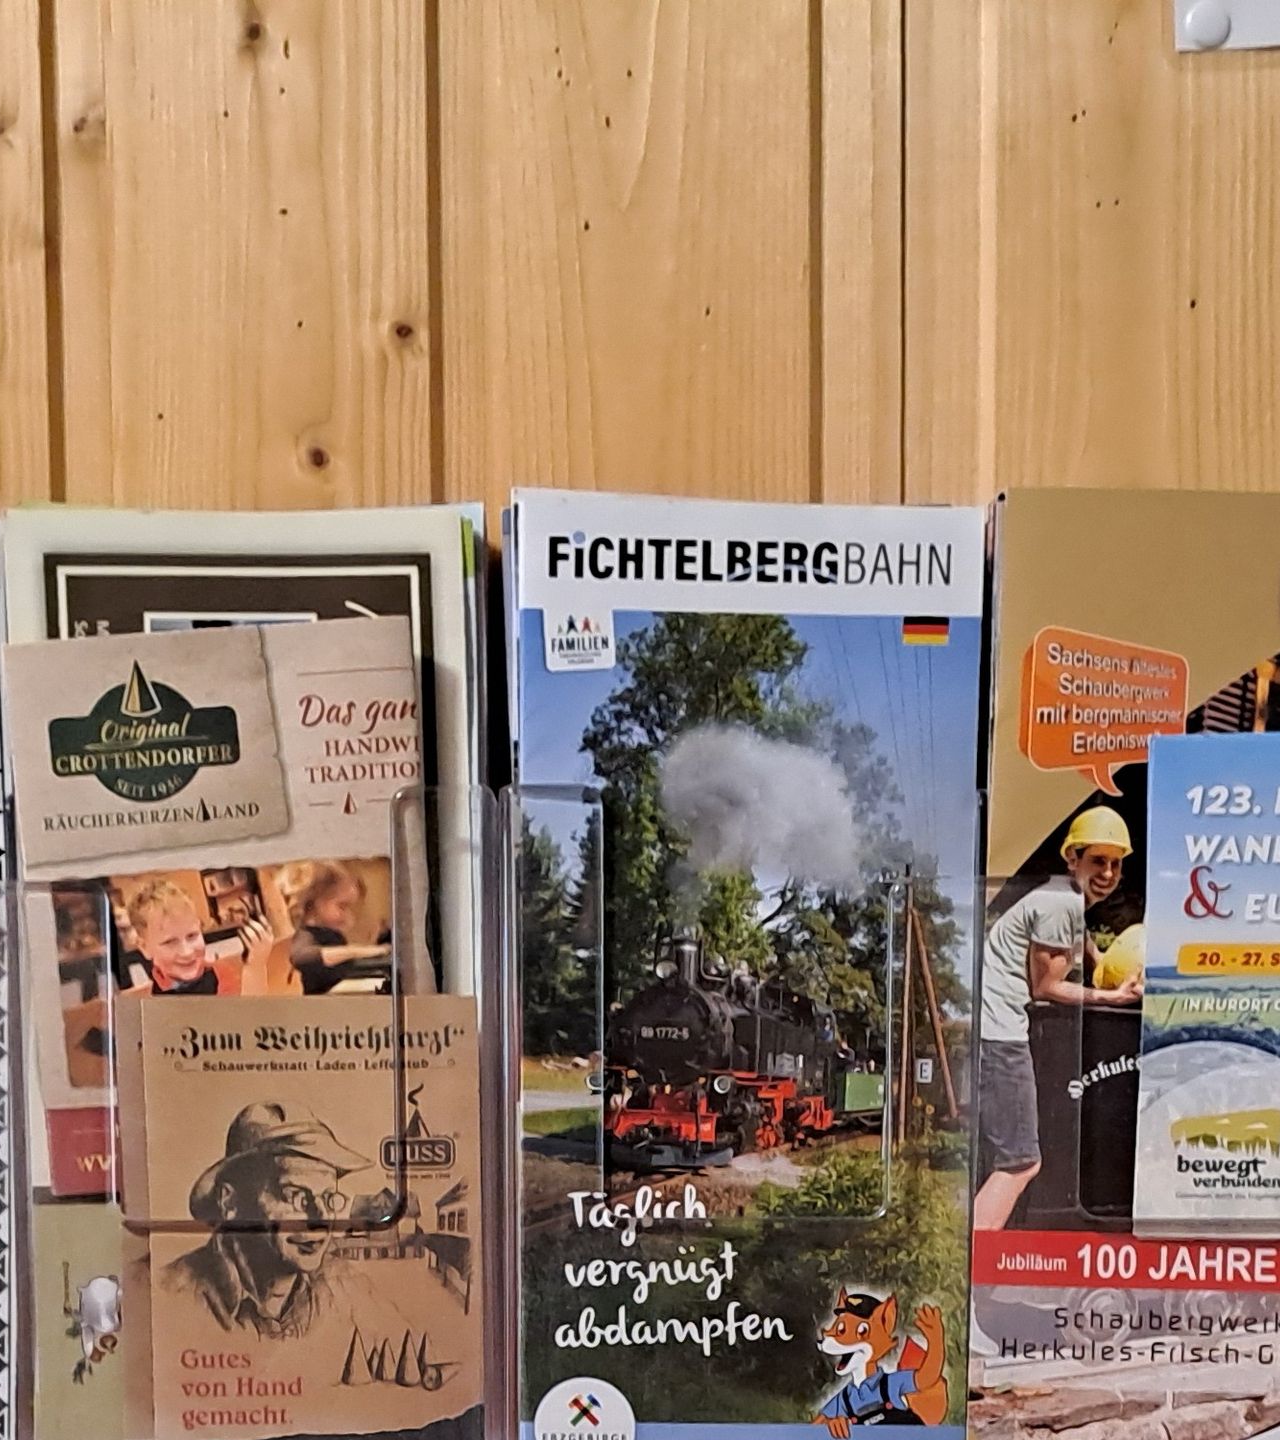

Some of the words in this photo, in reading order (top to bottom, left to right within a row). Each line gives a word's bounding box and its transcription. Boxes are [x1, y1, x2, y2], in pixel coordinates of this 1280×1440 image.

[551, 635, 610, 653] FAMILIEN
[1047, 642, 1131, 674] Sachsens
[1058, 672, 1170, 704] Schaubergwerk
[298, 693, 356, 728] Das
[1036, 701, 1068, 724] mit
[100, 711, 191, 748] Original
[55, 743, 235, 775] CROTTENDORFER
[114, 778, 145, 798] SEIT
[1185, 786, 1263, 817] 123.
[43, 804, 195, 833] RÄUCHERKERZEN
[210, 801, 261, 820] LAND
[1183, 866, 1234, 920] &
[1197, 951, 1226, 967] 20.
[1241, 951, 1266, 968] 27.
[1205, 997, 1271, 1013] KURORT
[315, 1059, 357, 1072] Laden
[919, 1060, 931, 1080] E
[1177, 1153, 1268, 1179] bewegt
[566, 1183, 710, 1246] Täglich
[564, 1240, 738, 1304] vergnügt
[996, 1251, 1068, 1273] Jubiläum
[1077, 1243, 1138, 1280] 100
[1148, 1246, 1277, 1282] JAHRE
[554, 1301, 794, 1357] abdampfen
[180, 1348, 252, 1370] Gutes
[181, 1379, 227, 1398] von
[235, 1376, 303, 1398] Hand
[181, 1404, 294, 1431] gemacht.
